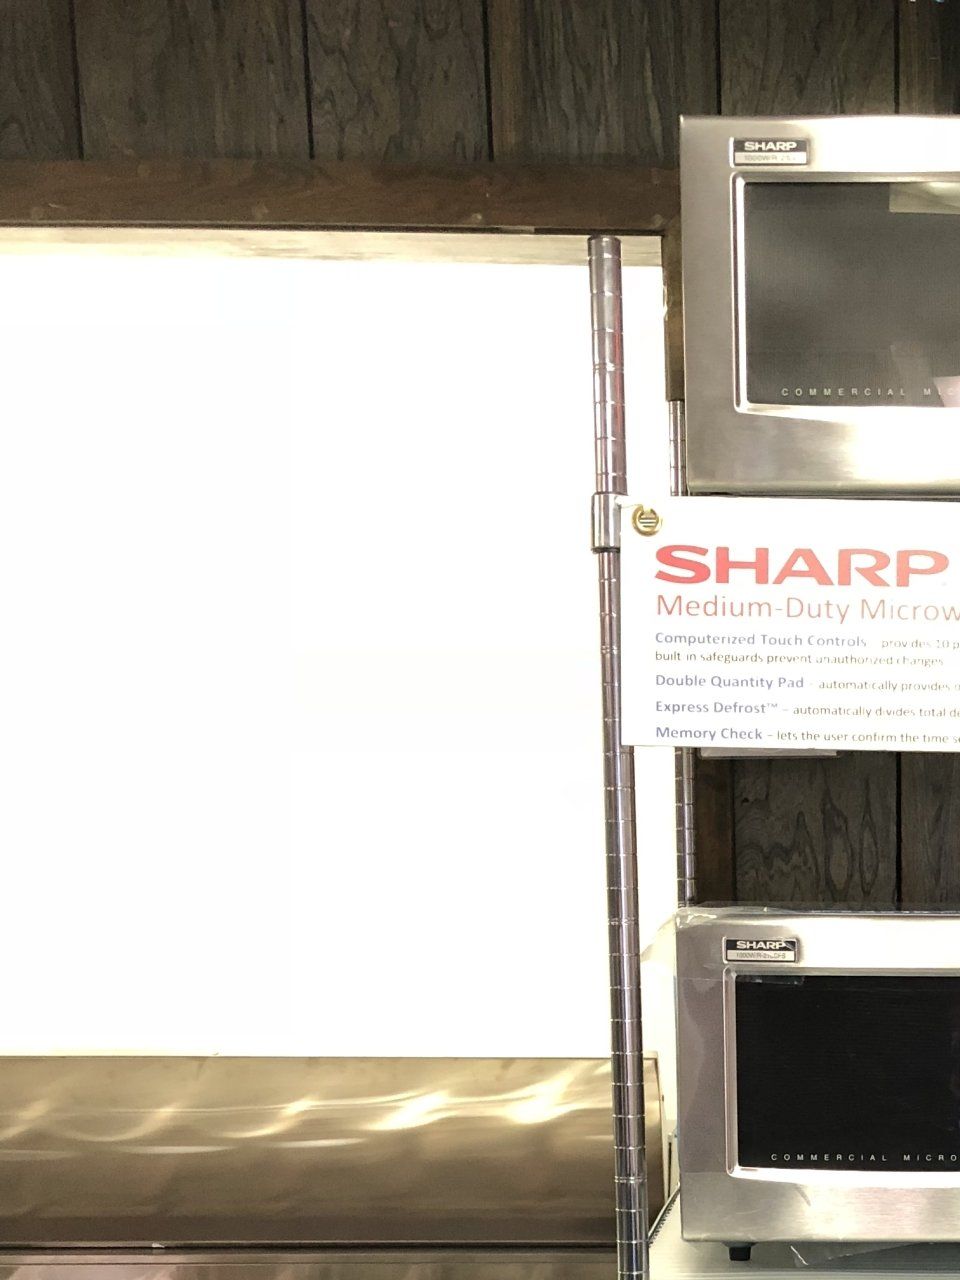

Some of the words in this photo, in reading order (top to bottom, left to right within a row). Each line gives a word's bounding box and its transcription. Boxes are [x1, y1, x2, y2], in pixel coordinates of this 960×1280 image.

[744, 141, 797, 151] SHARP
[781, 387, 905, 397] COMMERCIAL
[655, 545, 950, 587] SHARP
[657, 594, 850, 625] Medium-Duty
[655, 632, 755, 649] Computerized
[760, 634, 802, 647] Touch
[807, 632, 866, 647] Controls
[656, 674, 706, 688] Double
[711, 676, 773, 690] Quantity
[778, 677, 804, 688] Pad
[656, 701, 709, 715] Express
[656, 727, 716, 742] Memory
[721, 727, 763, 741] Check
[736, 941, 786, 950] SHARP
[771, 1153, 888, 1162] COMMERCIAL
